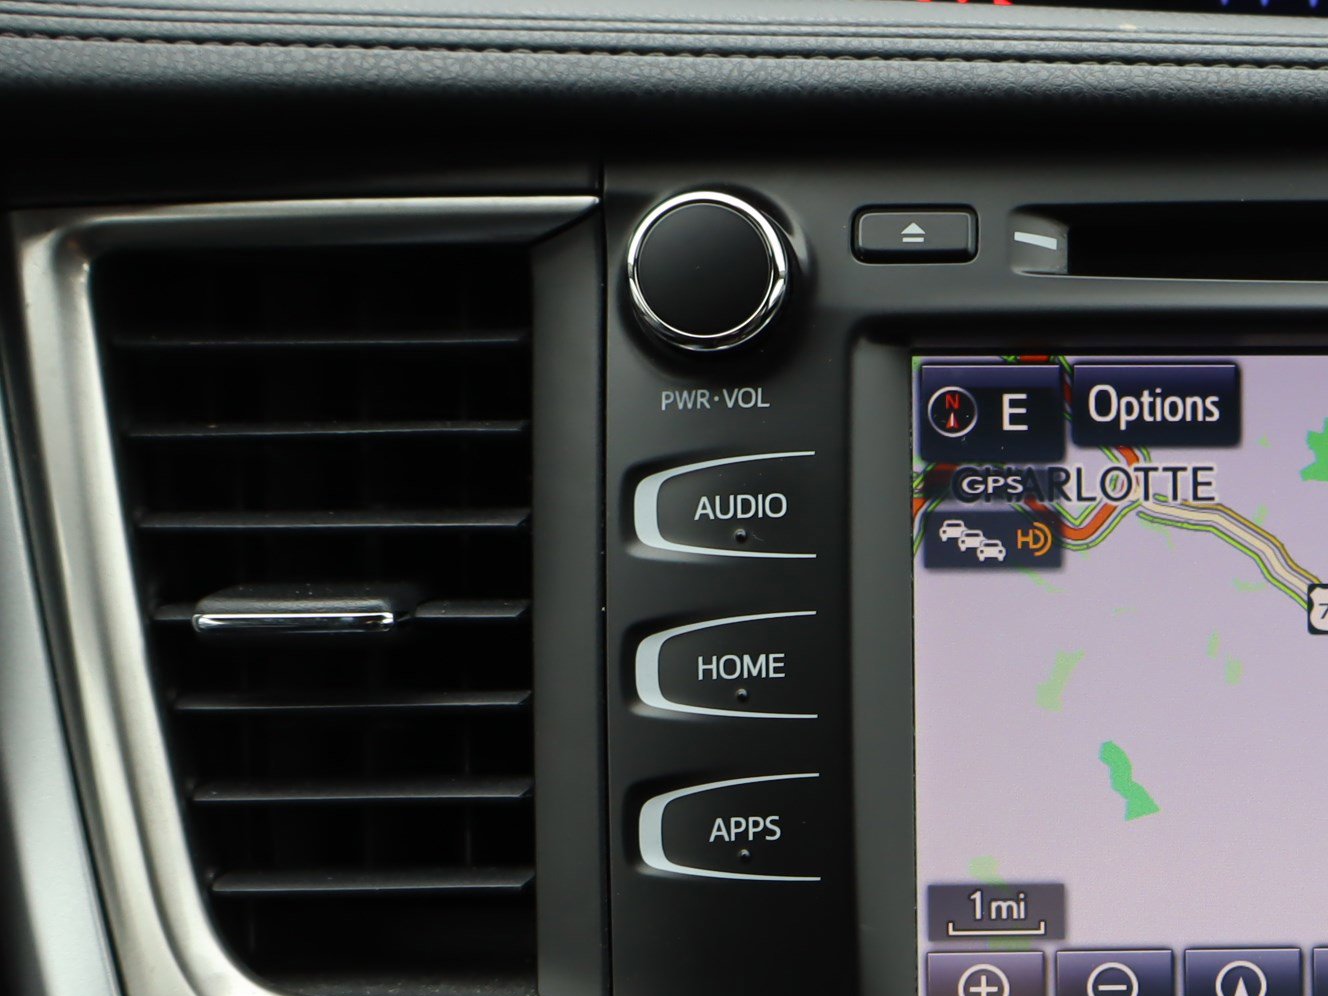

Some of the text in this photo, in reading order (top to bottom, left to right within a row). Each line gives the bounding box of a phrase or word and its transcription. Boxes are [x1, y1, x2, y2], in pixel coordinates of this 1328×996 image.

[945, 393, 961, 409] N
[1002, 393, 1028, 430] E
[1088, 384, 1220, 430] Options
[961, 476, 1024, 494] GPS
[694, 492, 788, 521] AUDIO
[697, 653, 786, 681] HOME
[709, 815, 782, 843] APPS
[968, 890, 1028, 920] 1 mi
